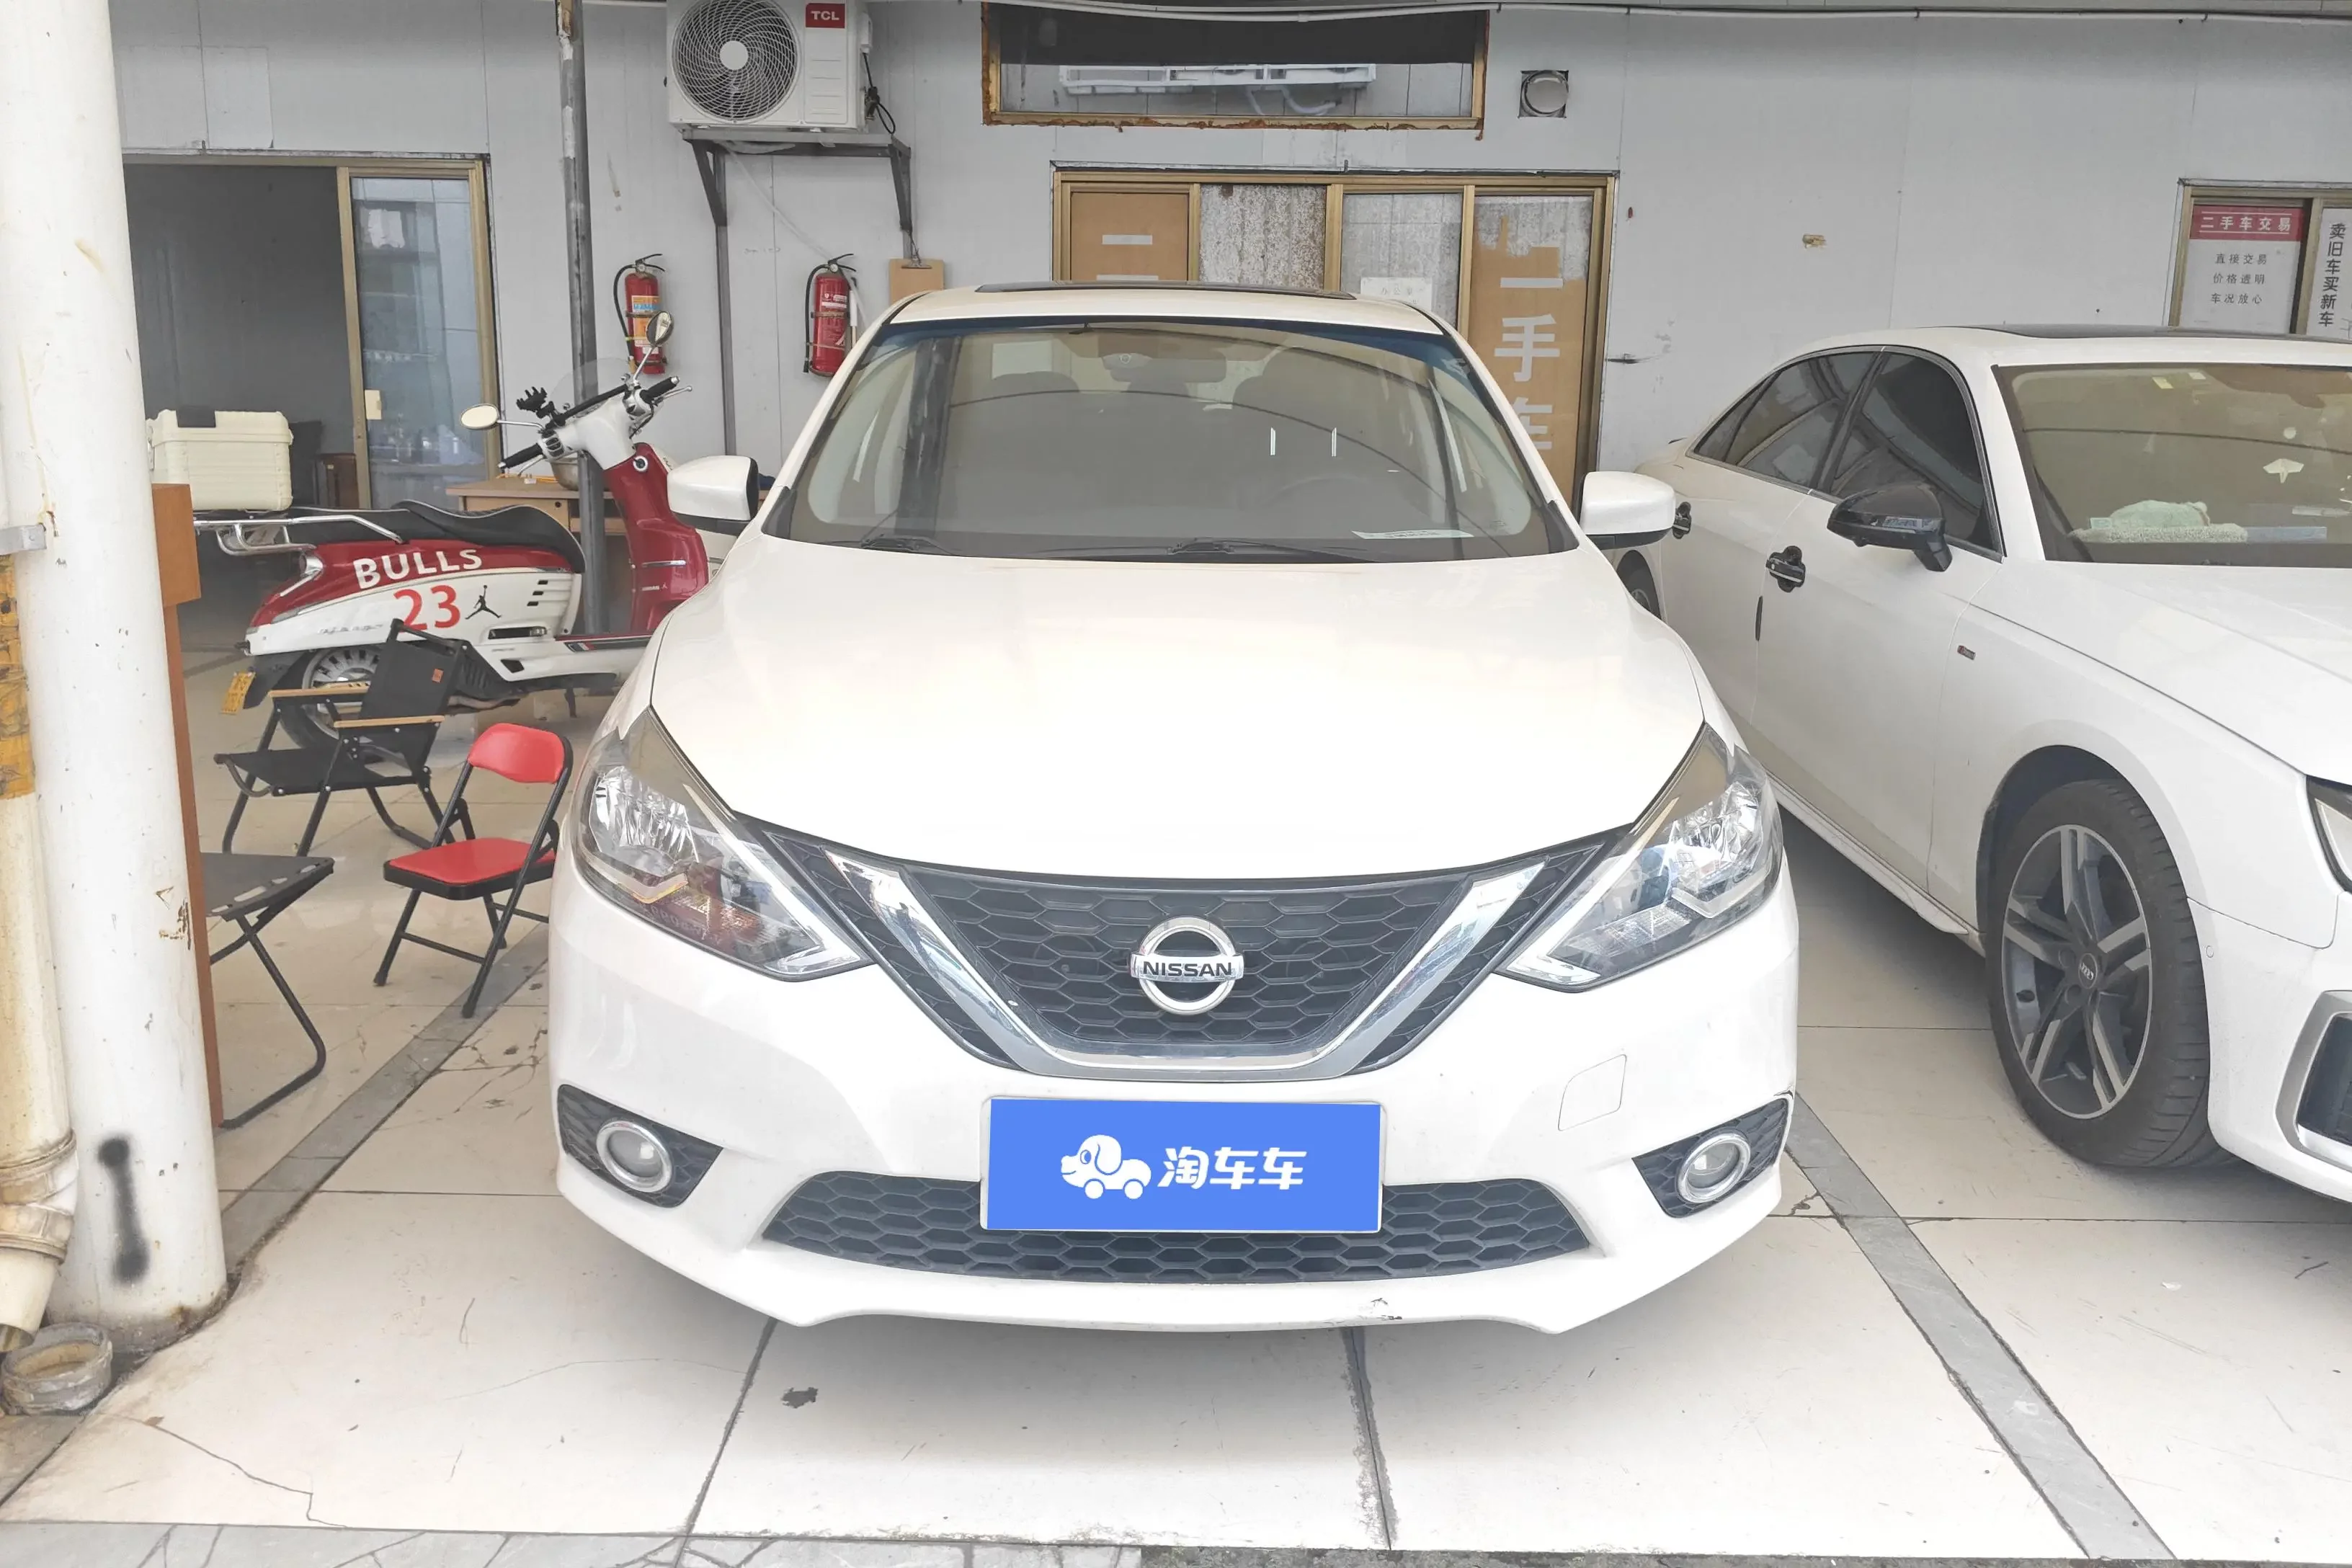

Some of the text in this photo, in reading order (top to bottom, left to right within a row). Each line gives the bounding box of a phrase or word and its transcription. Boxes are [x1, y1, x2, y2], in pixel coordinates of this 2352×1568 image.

[811, 10, 840, 21] TCL
[2201, 216, 2292, 232] 二手车交易
[2214, 254, 2268, 265] 直接交易
[2212, 272, 2266, 285] 价格透明
[2318, 223, 2347, 327] 卖旧车买新车
[2210, 293, 2263, 305] 车况放心
[353, 549, 482, 589] BULLS
[393, 584, 461, 633] 23
[1143, 961, 1231, 977] NISSAN
